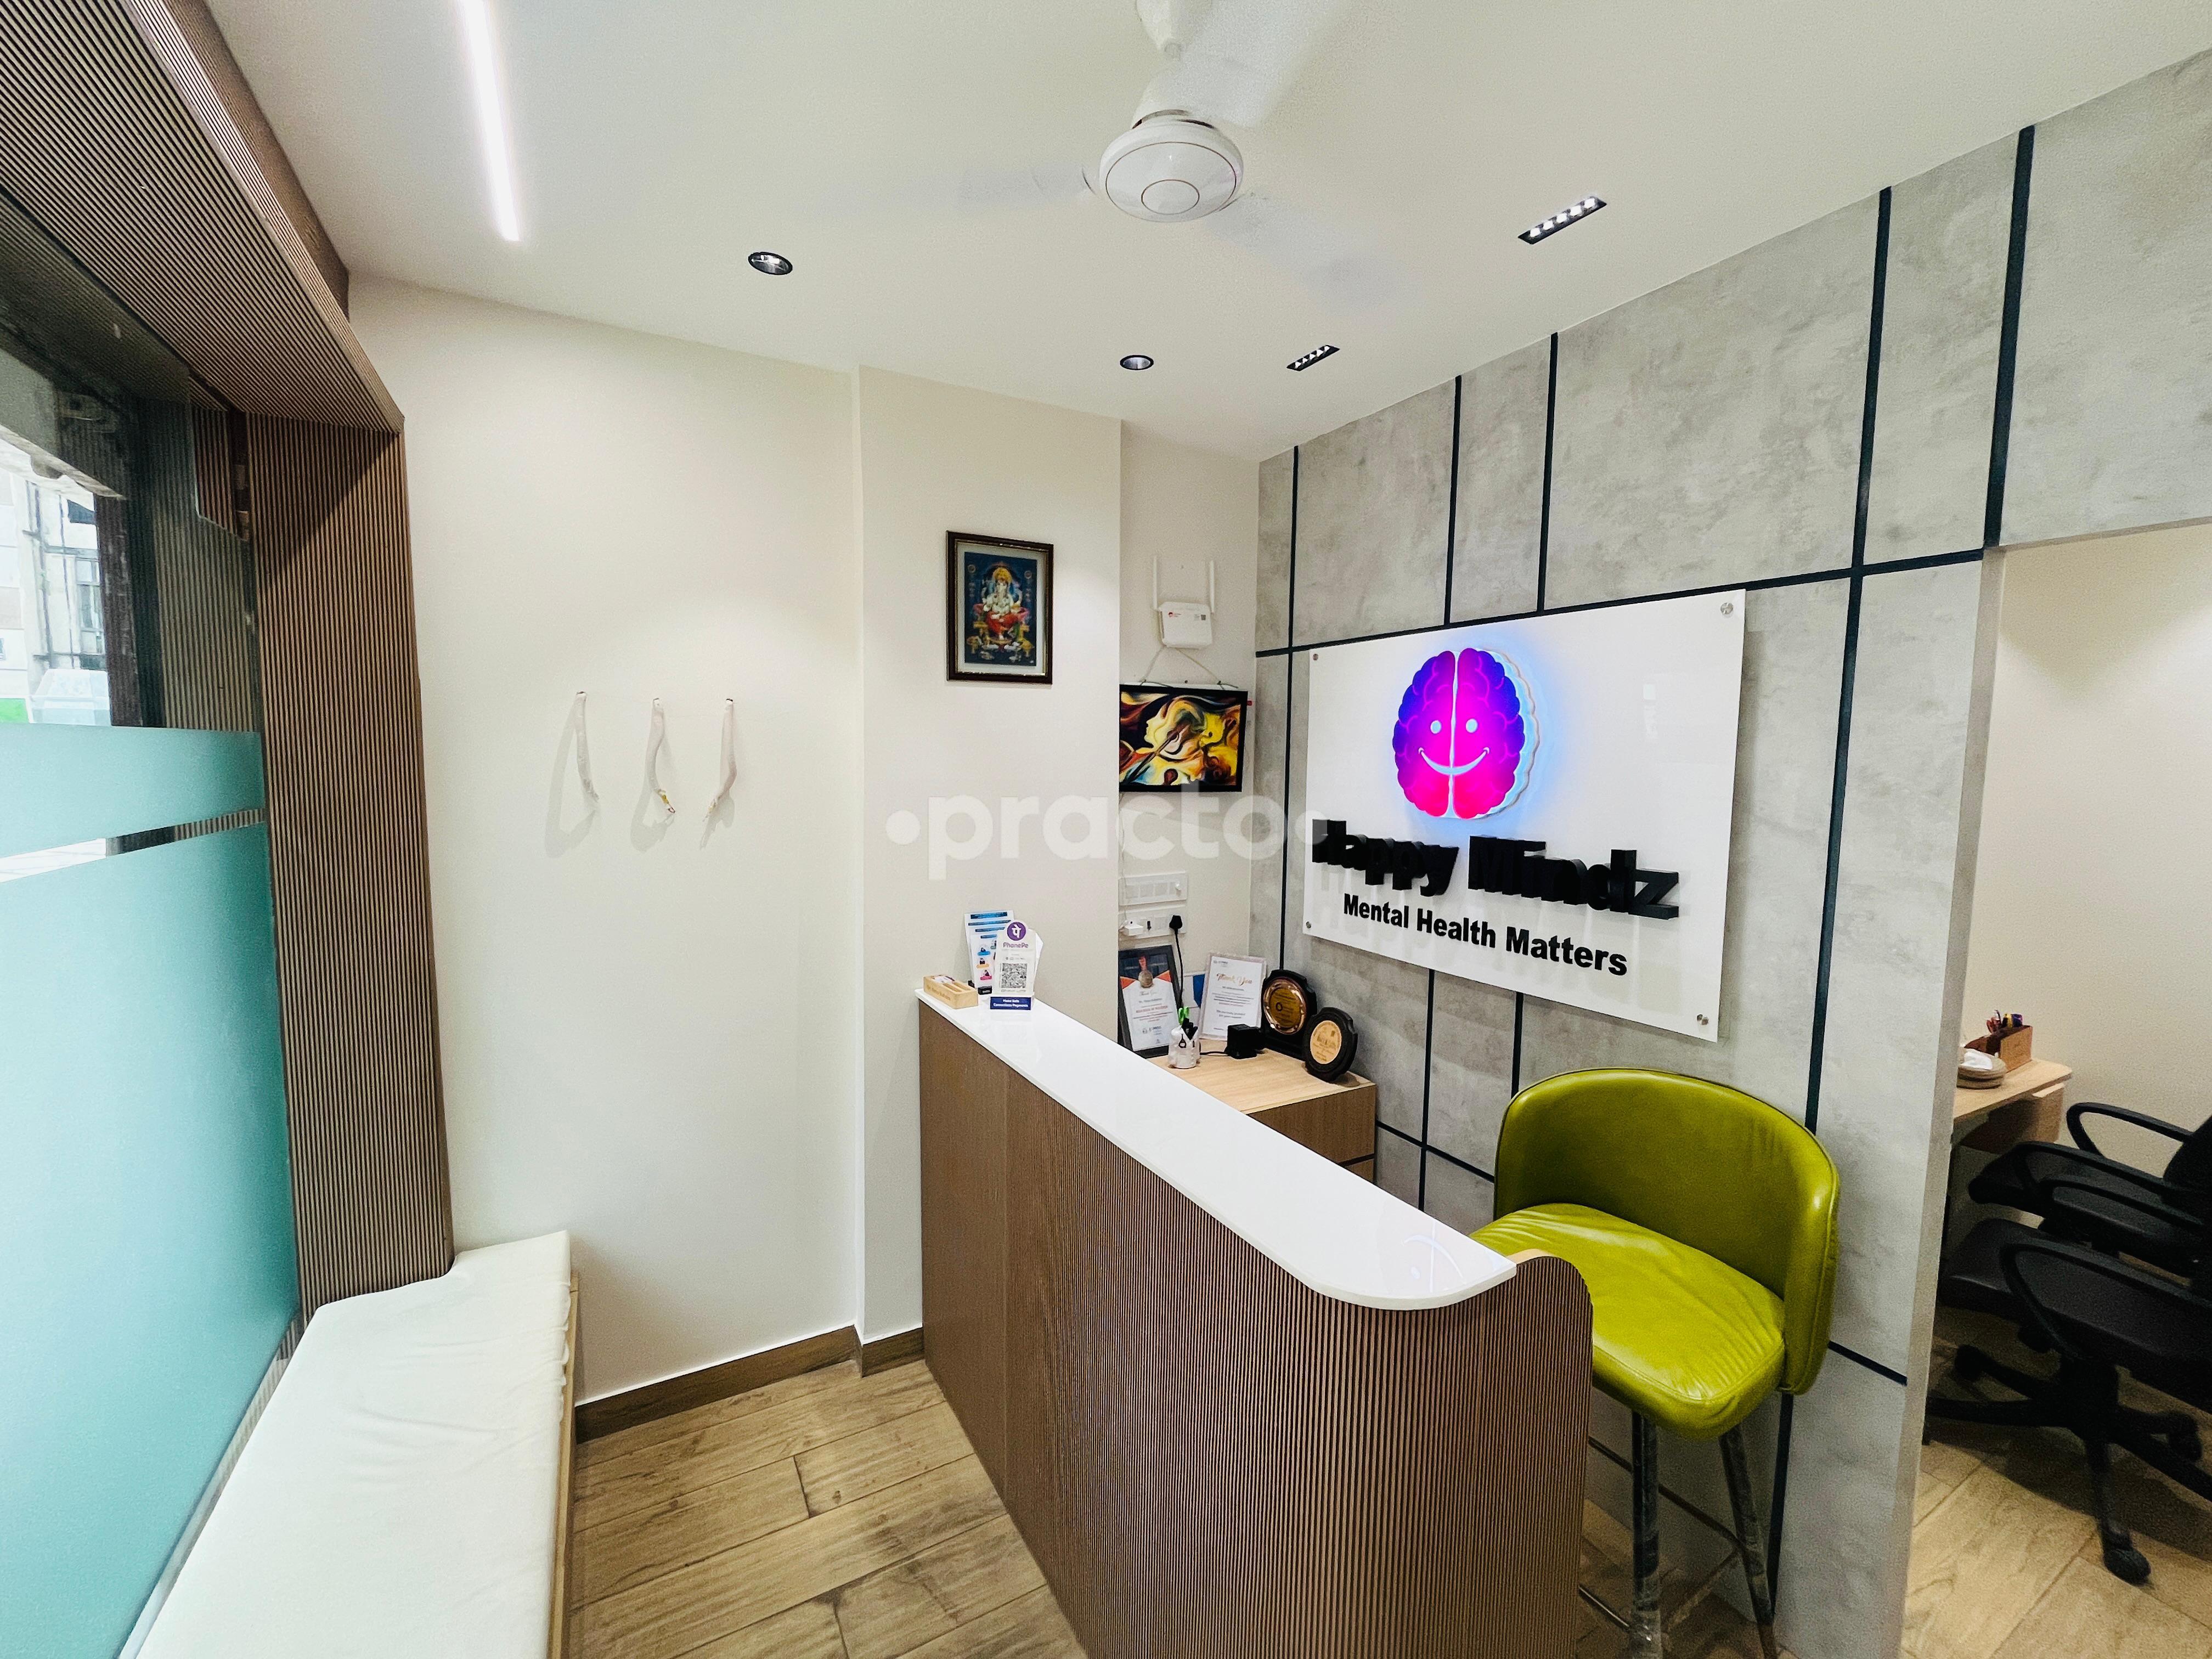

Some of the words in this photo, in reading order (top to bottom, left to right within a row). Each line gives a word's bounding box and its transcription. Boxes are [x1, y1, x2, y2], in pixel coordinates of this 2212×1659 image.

[1344, 893, 1409, 928] Mental
[1417, 908, 1497, 949] Health
[1506, 926, 1627, 976] Matters
